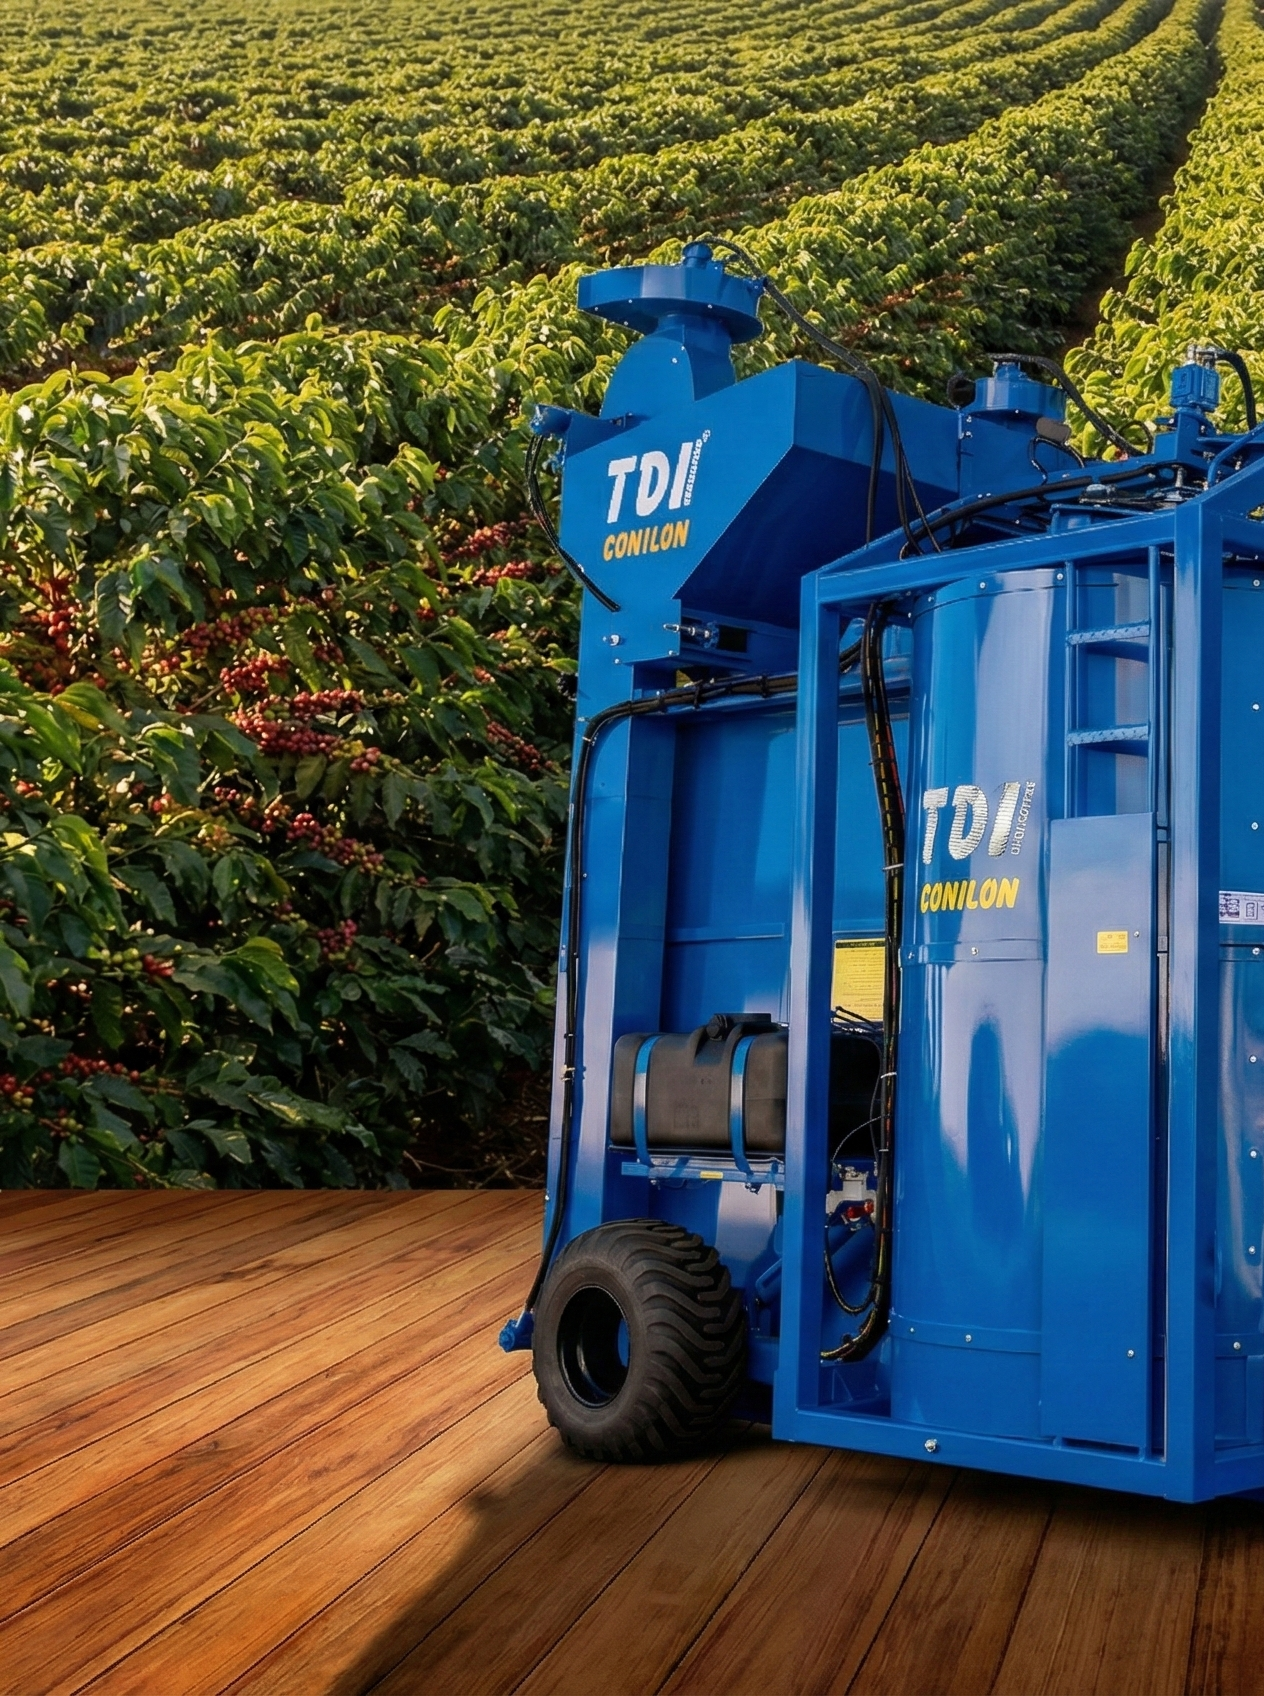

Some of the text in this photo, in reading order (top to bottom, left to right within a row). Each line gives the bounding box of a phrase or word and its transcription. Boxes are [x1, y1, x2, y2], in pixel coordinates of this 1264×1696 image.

[607, 441, 693, 523] TDI
[603, 519, 690, 561] CONILON
[922, 781, 1020, 865] TDI
[920, 878, 1019, 913] CONILON
